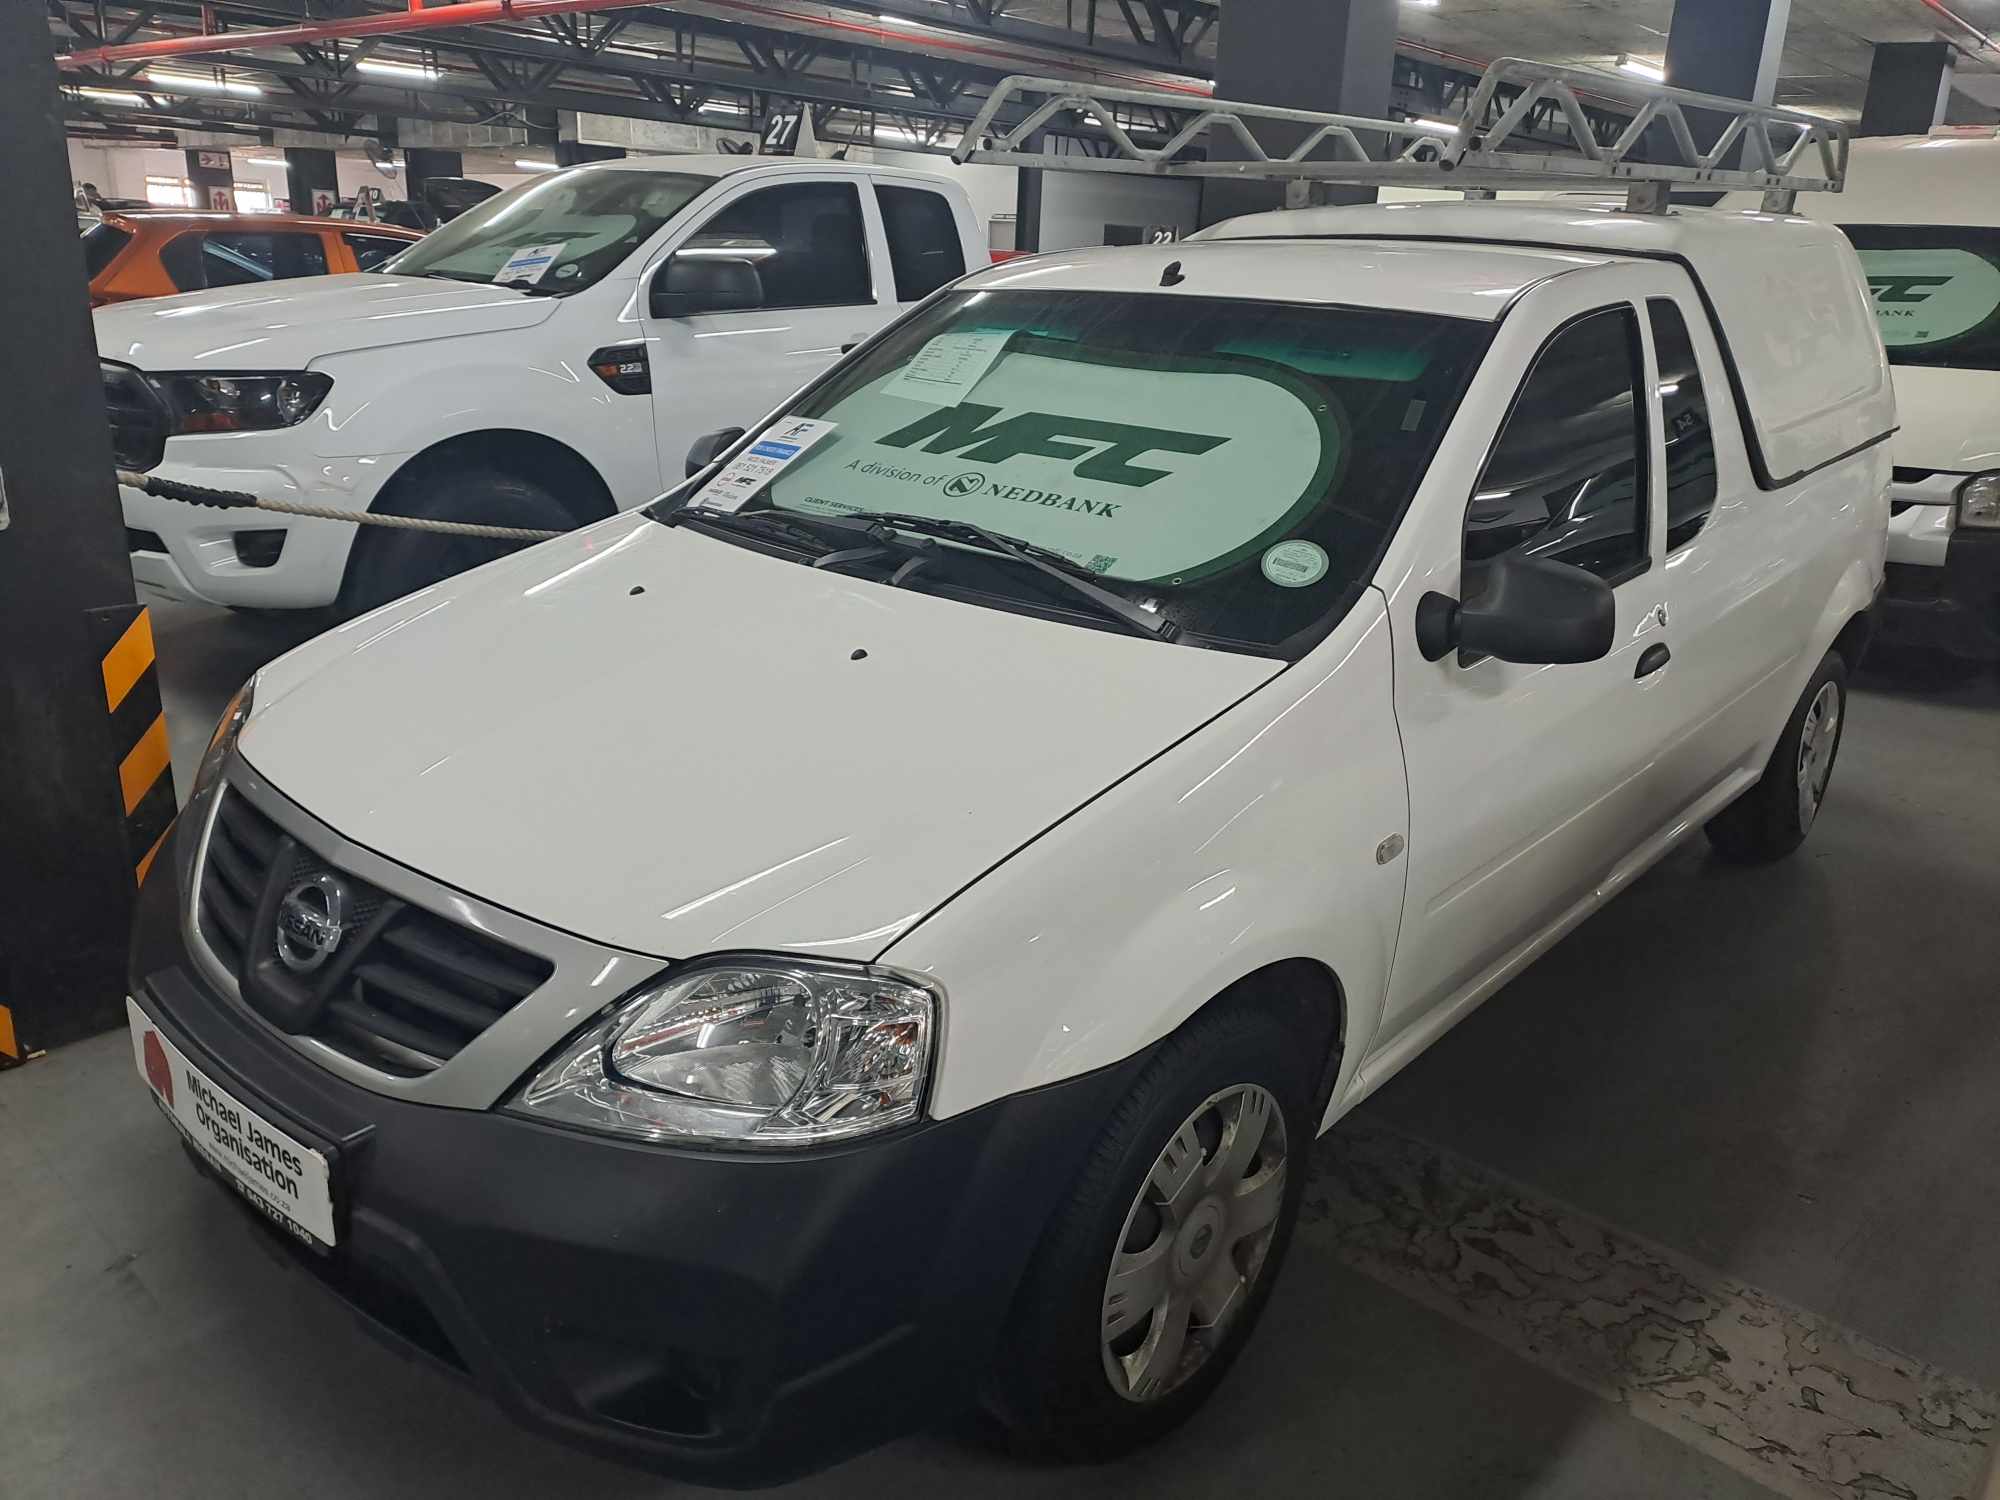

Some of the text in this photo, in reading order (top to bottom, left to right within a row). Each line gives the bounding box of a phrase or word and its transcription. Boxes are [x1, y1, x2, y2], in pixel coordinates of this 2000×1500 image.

[765, 114, 798, 144] 27
[874, 402, 1232, 488] MFC
[804, 496, 829, 506] CLIENT
[844, 459, 1122, 518] A division of NEDBANK
[185, 1069, 304, 1177] Michael James
[195, 1103, 300, 1200] Organisation
